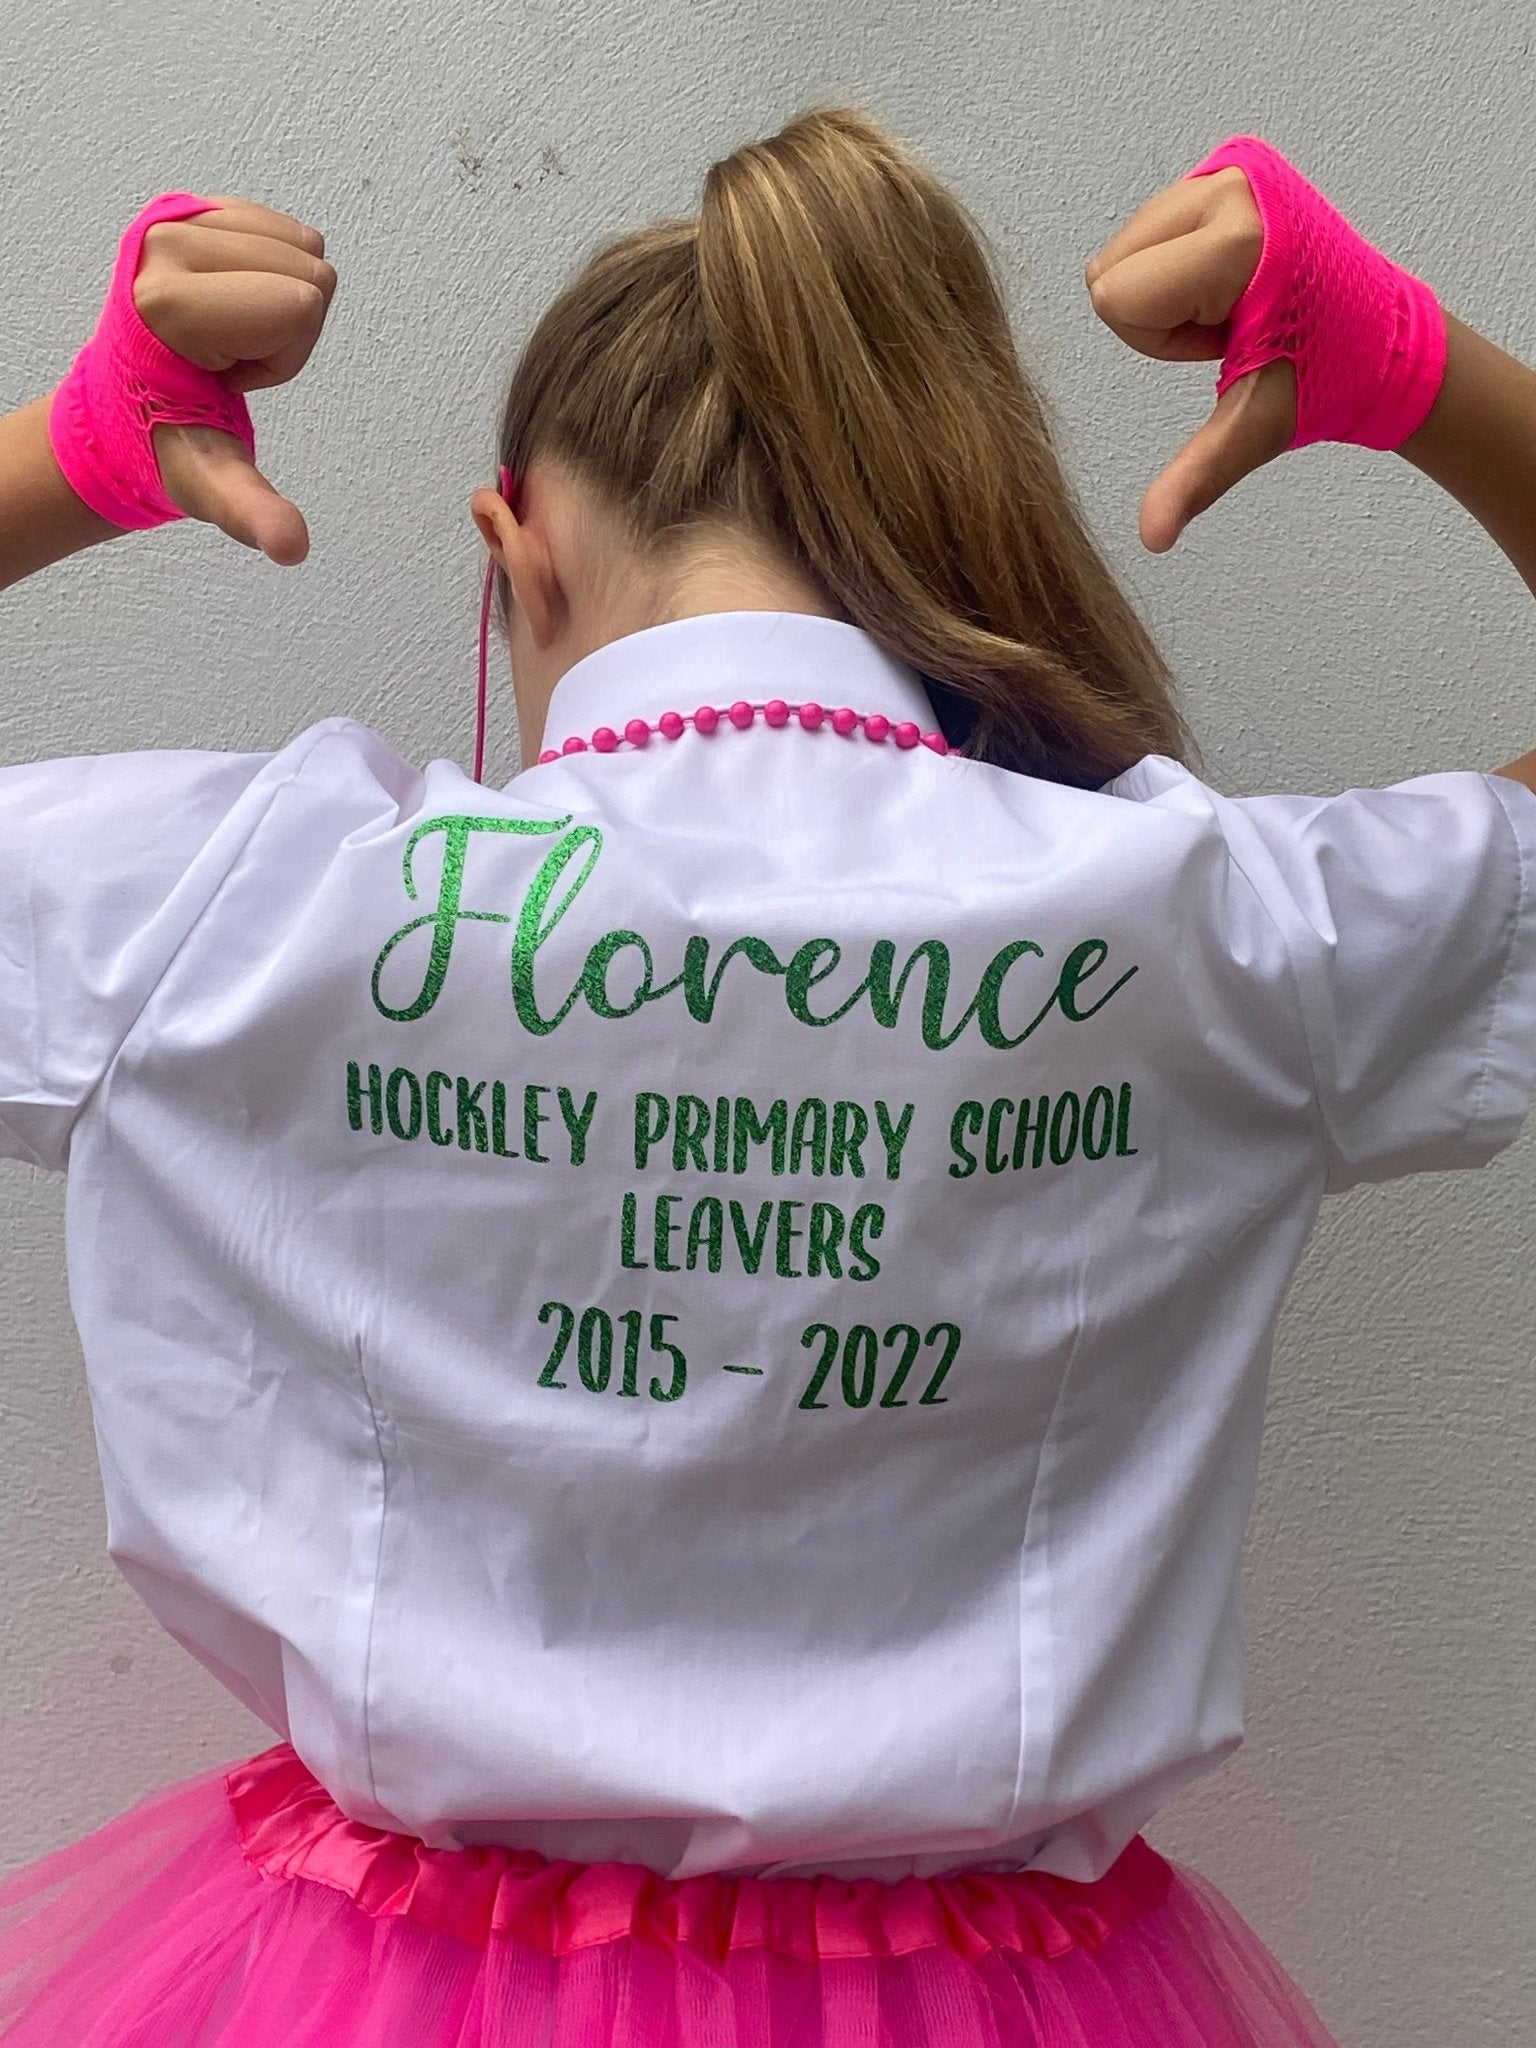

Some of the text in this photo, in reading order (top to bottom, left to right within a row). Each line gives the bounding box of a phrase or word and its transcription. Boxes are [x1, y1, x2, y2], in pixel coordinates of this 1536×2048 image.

[371, 813, 1140, 1051] Florence
[345, 1060, 1139, 1180] HOCKLEY PRIMARY SCHOOL
[620, 1191, 885, 1282] LEAVERS
[537, 1301, 688, 1403] 2015
[798, 1322, 962, 1410] 2022
